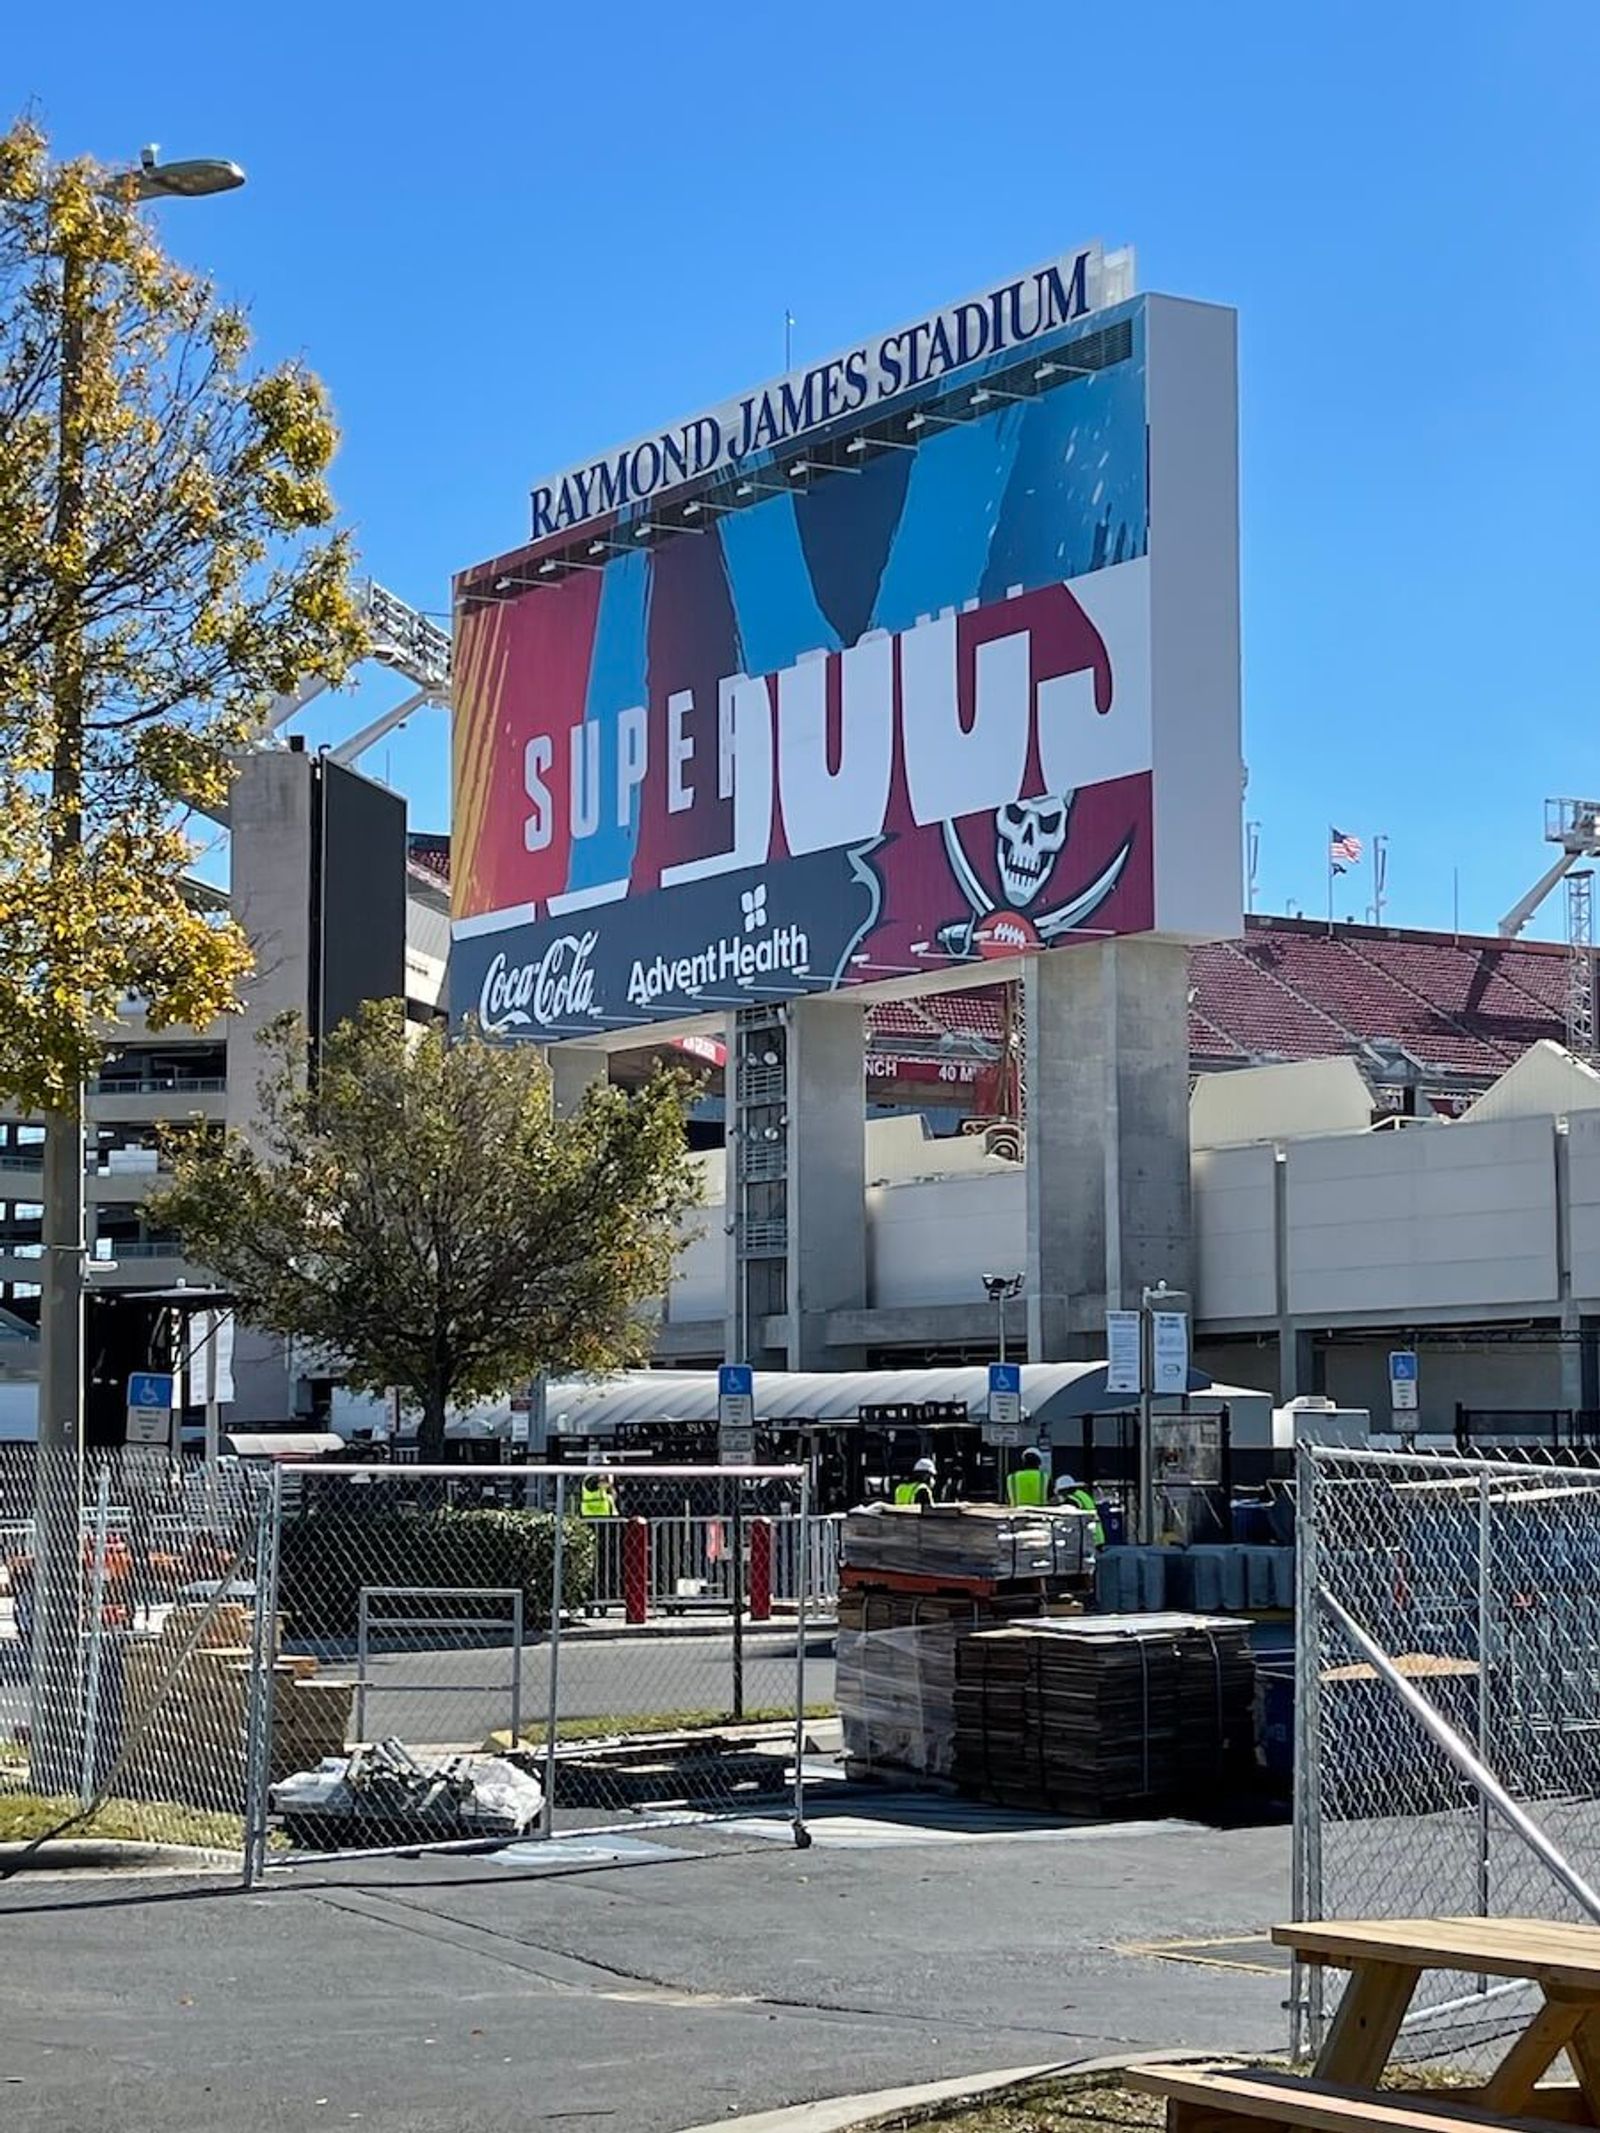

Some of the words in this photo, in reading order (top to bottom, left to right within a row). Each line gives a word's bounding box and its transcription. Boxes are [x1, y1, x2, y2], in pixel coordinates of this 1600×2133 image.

[530, 416, 721, 541] RAYMOND
[727, 349, 868, 461] JAMES
[878, 251, 1092, 398] STADIUM
[626, 923, 808, 1003] AdventHealth
